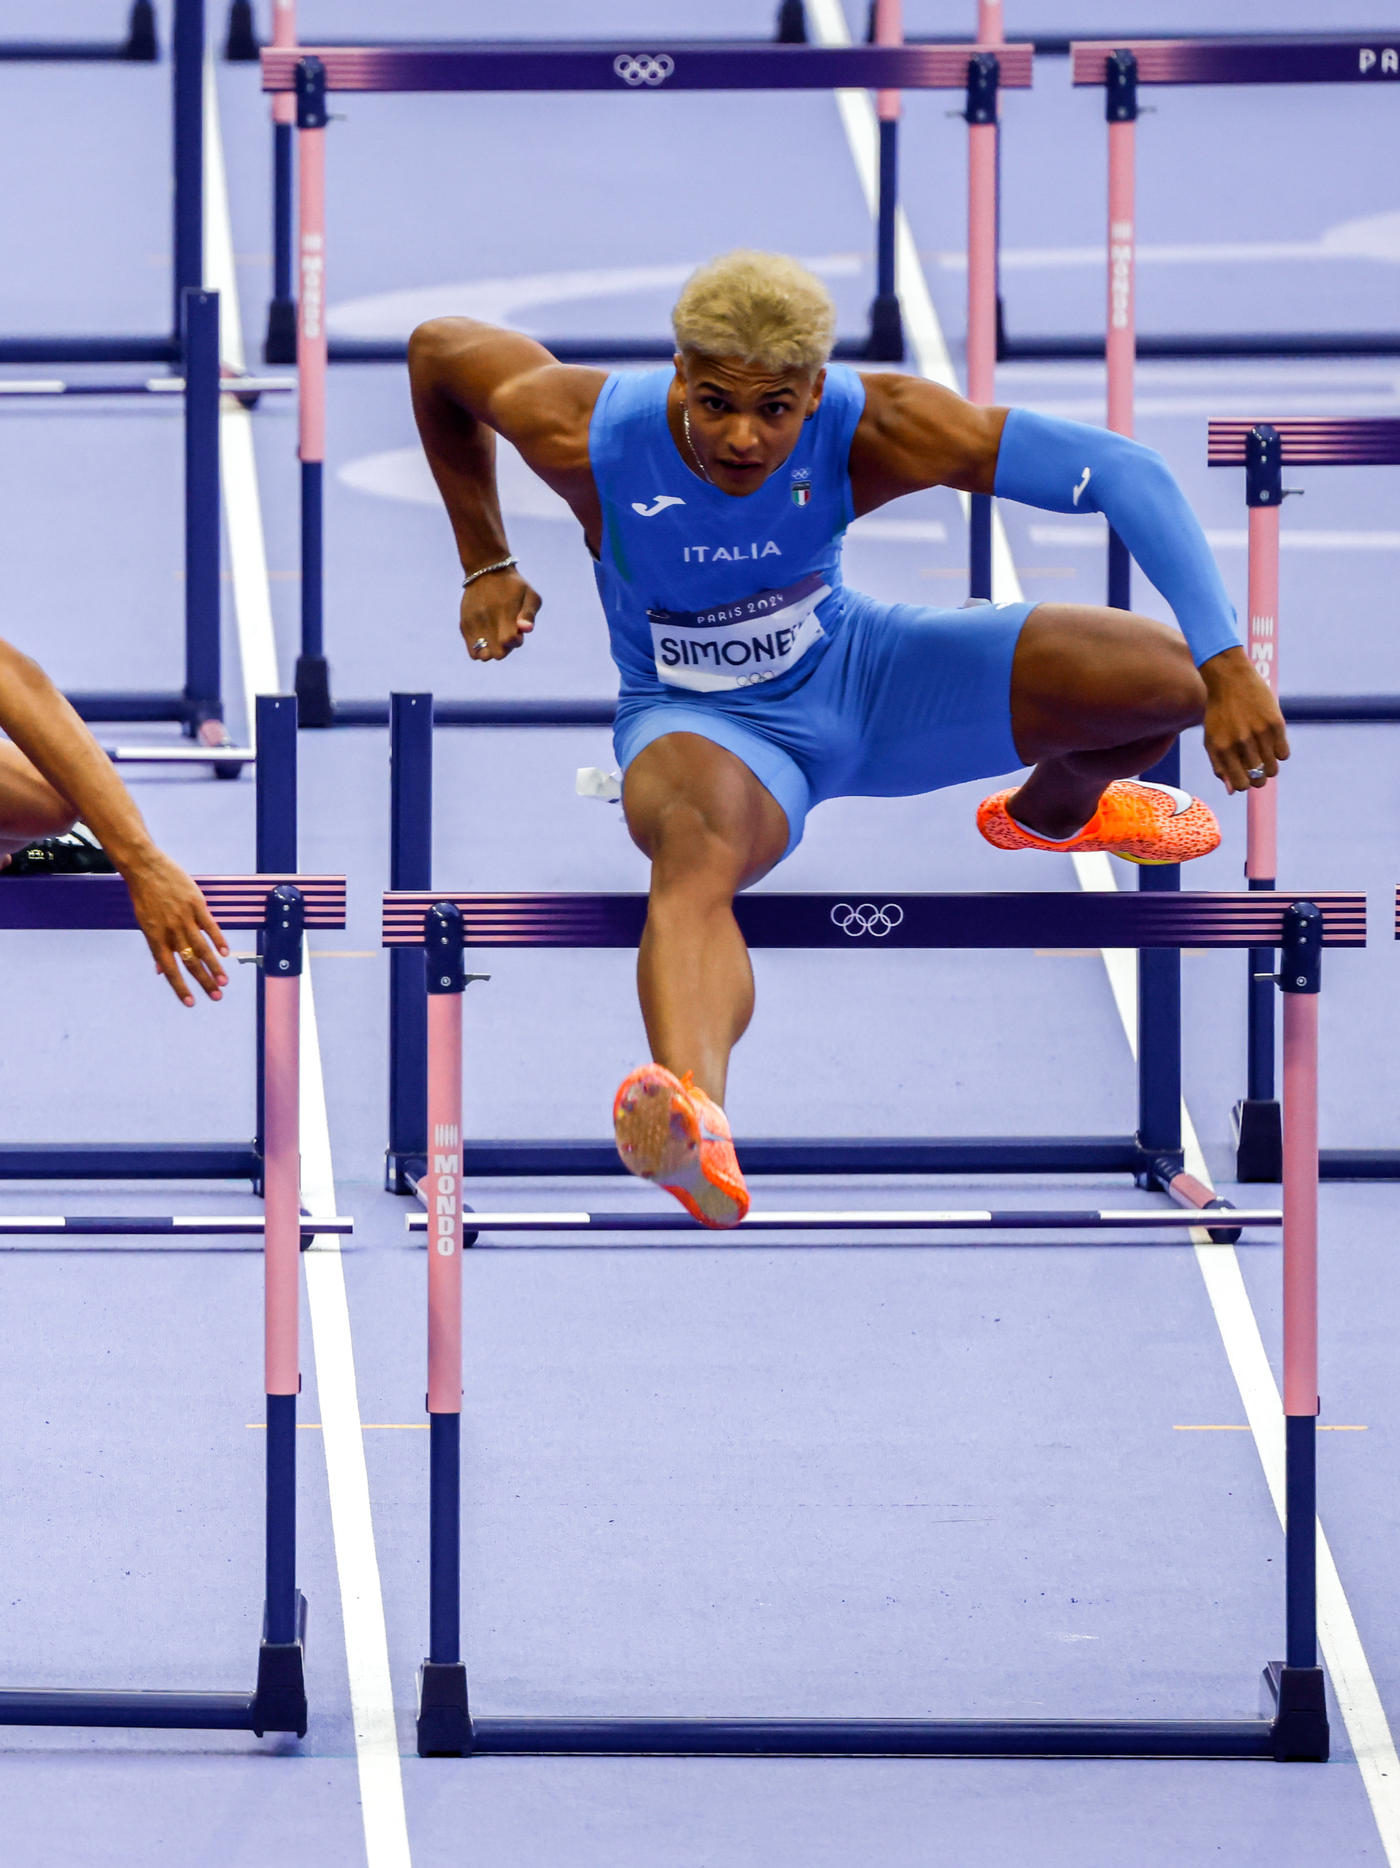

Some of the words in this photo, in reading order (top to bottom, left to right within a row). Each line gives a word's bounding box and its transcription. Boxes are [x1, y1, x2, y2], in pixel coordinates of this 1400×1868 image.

[684, 540, 782, 563] ITALIA
[749, 593, 784, 614] 2024
[434, 1154, 459, 1256] MONDO
